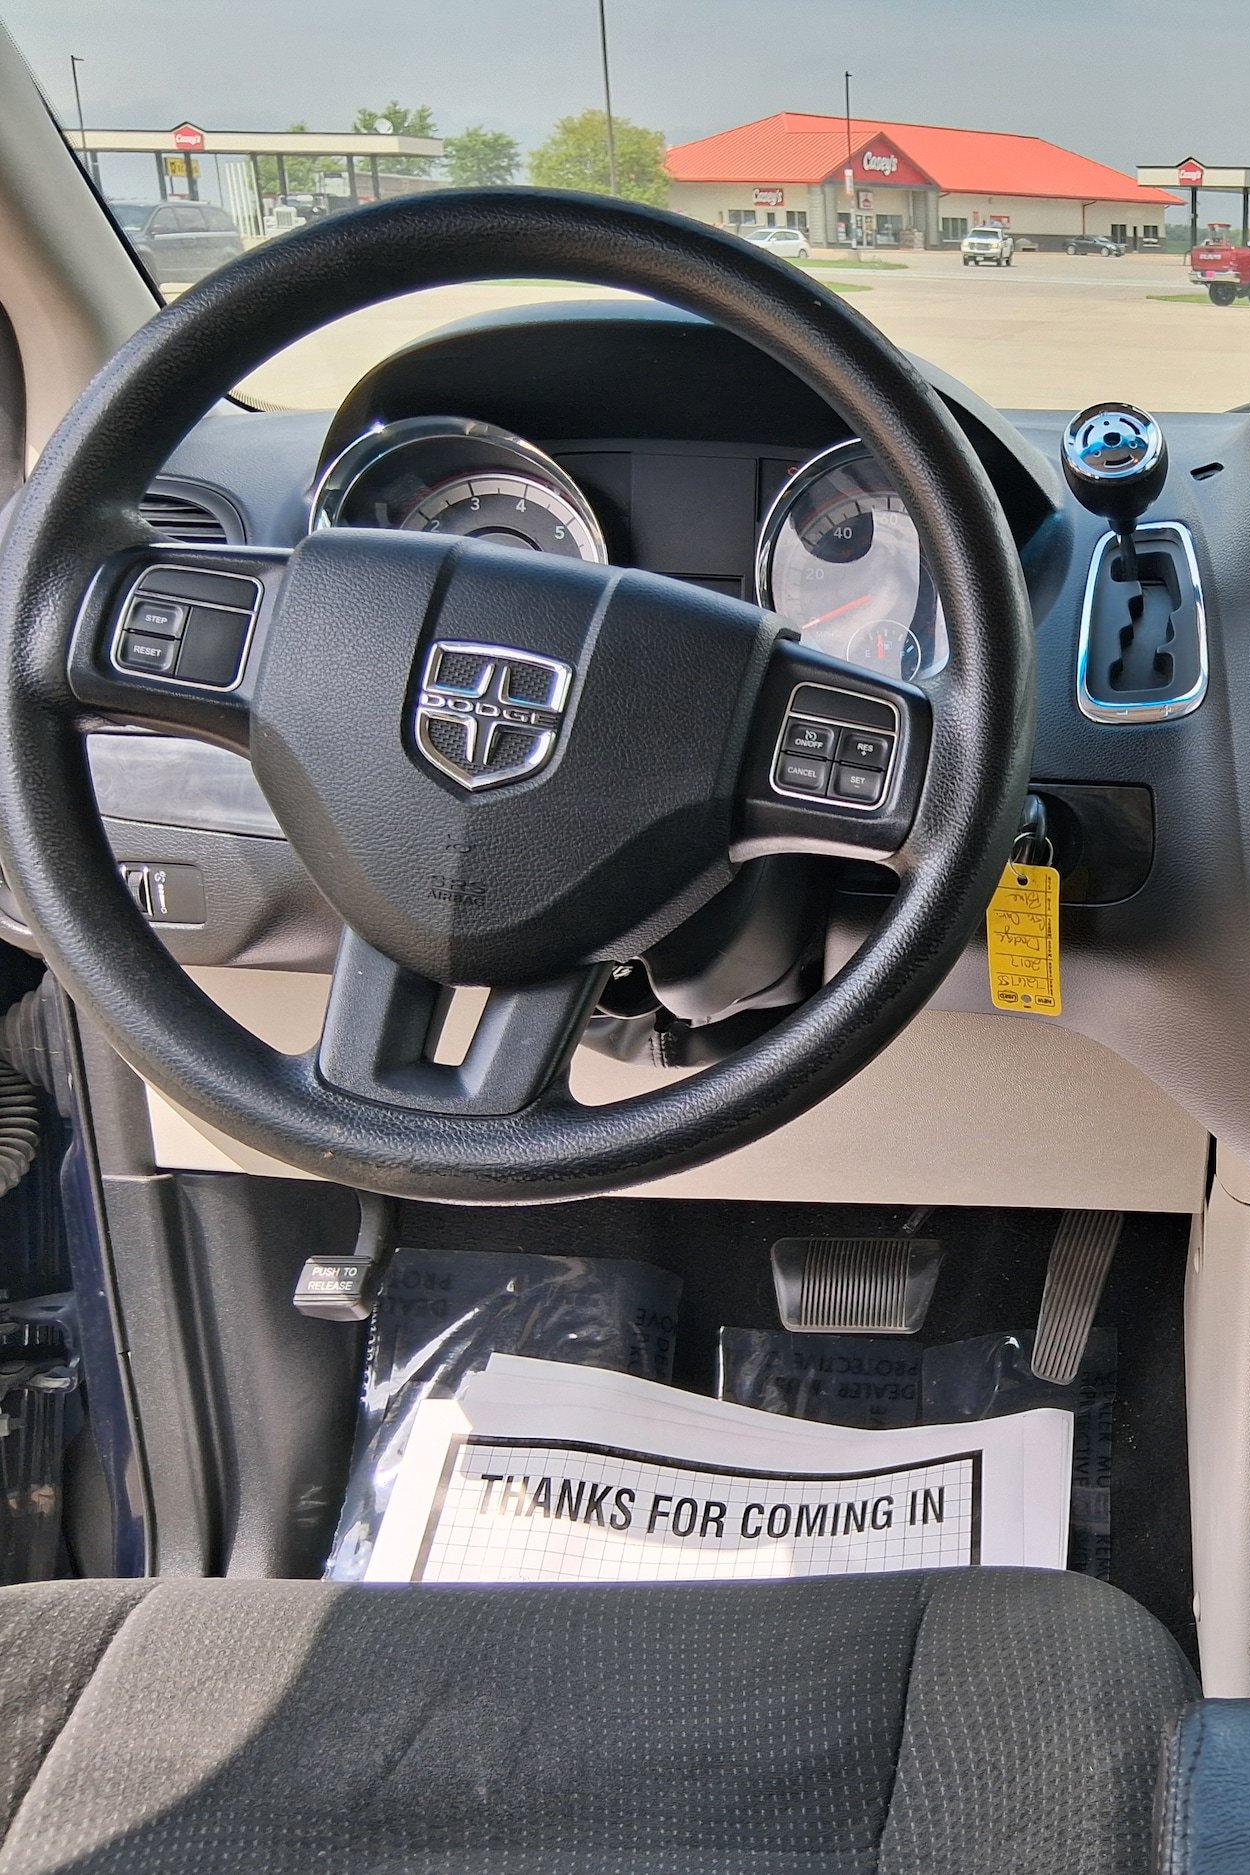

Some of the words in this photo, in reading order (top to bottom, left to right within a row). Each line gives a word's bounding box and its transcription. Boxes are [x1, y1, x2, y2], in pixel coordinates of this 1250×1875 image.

[863, 151, 898, 176] Casey's
[752, 188, 783, 206] Casey's
[470, 497, 480, 511] 3
[515, 499, 526, 513] 4
[430, 520, 440, 532] 2
[554, 525, 565, 539] 5
[833, 527, 853, 540] 40
[805, 568, 825, 580] 20
[145, 614, 168, 624] STEP
[134, 645, 162, 657] RESET
[421, 692, 560, 725] DODGE
[794, 738, 824, 749] ON/OFF
[857, 742, 874, 753] RES
[787, 766, 817, 778] CANCEL
[850, 775, 866, 785] SET
[999, 925, 1040, 951] Dodge
[1010, 958, 1042, 971] 2017
[311, 1266, 341, 1277] PUSH
[343, 1267, 358, 1277] TO
[307, 1281, 353, 1291] RELEASE
[478, 1473, 636, 1532] THANKS
[646, 1494, 725, 1539] FOR
[740, 1495, 895, 1539] COMING
[908, 1486, 946, 1526] IN
